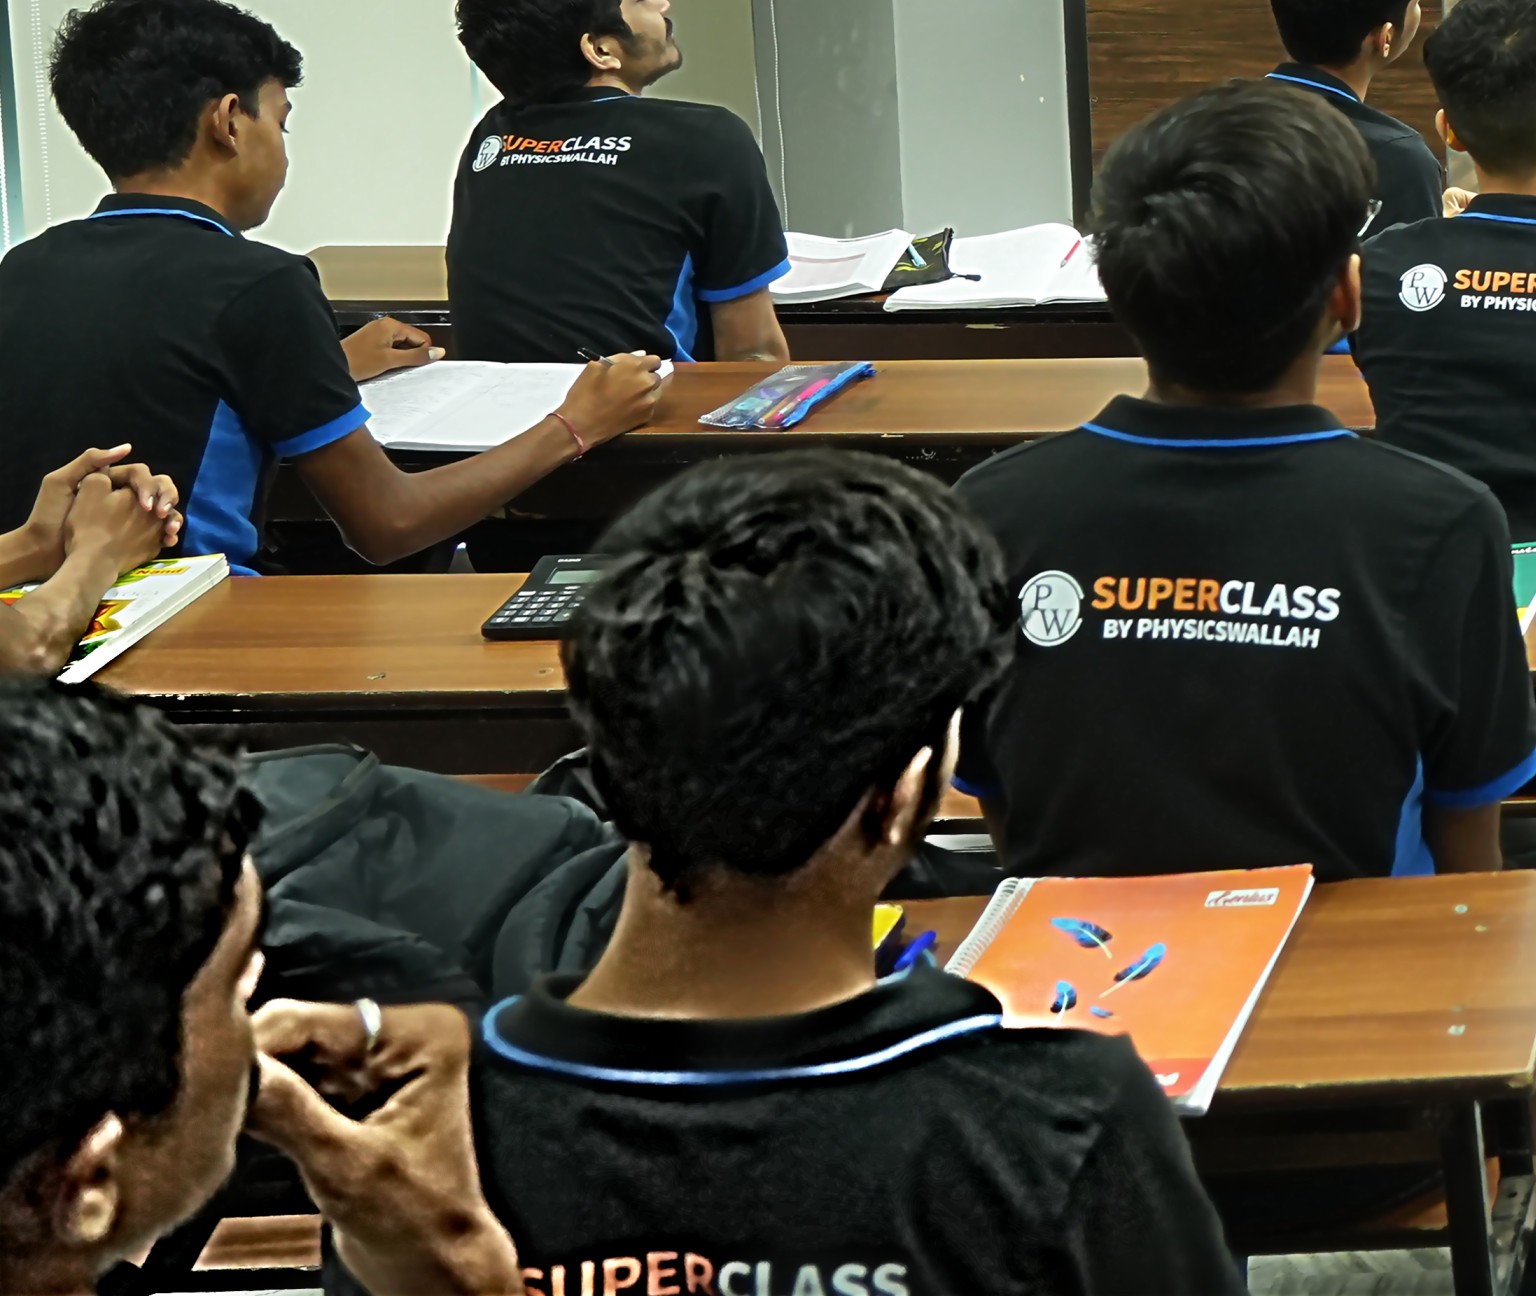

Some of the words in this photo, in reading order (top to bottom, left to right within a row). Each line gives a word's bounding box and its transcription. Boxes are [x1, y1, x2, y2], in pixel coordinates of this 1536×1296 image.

[502, 135, 632, 153] SUPERCLASS
[510, 153, 617, 166] PHYSICSWALLAH
[1460, 295, 1482, 309] BY
[1091, 576, 1341, 622] SUPERCLASS
[1103, 618, 1133, 639] BY
[1136, 619, 1320, 649] PHYSICSWALLAH
